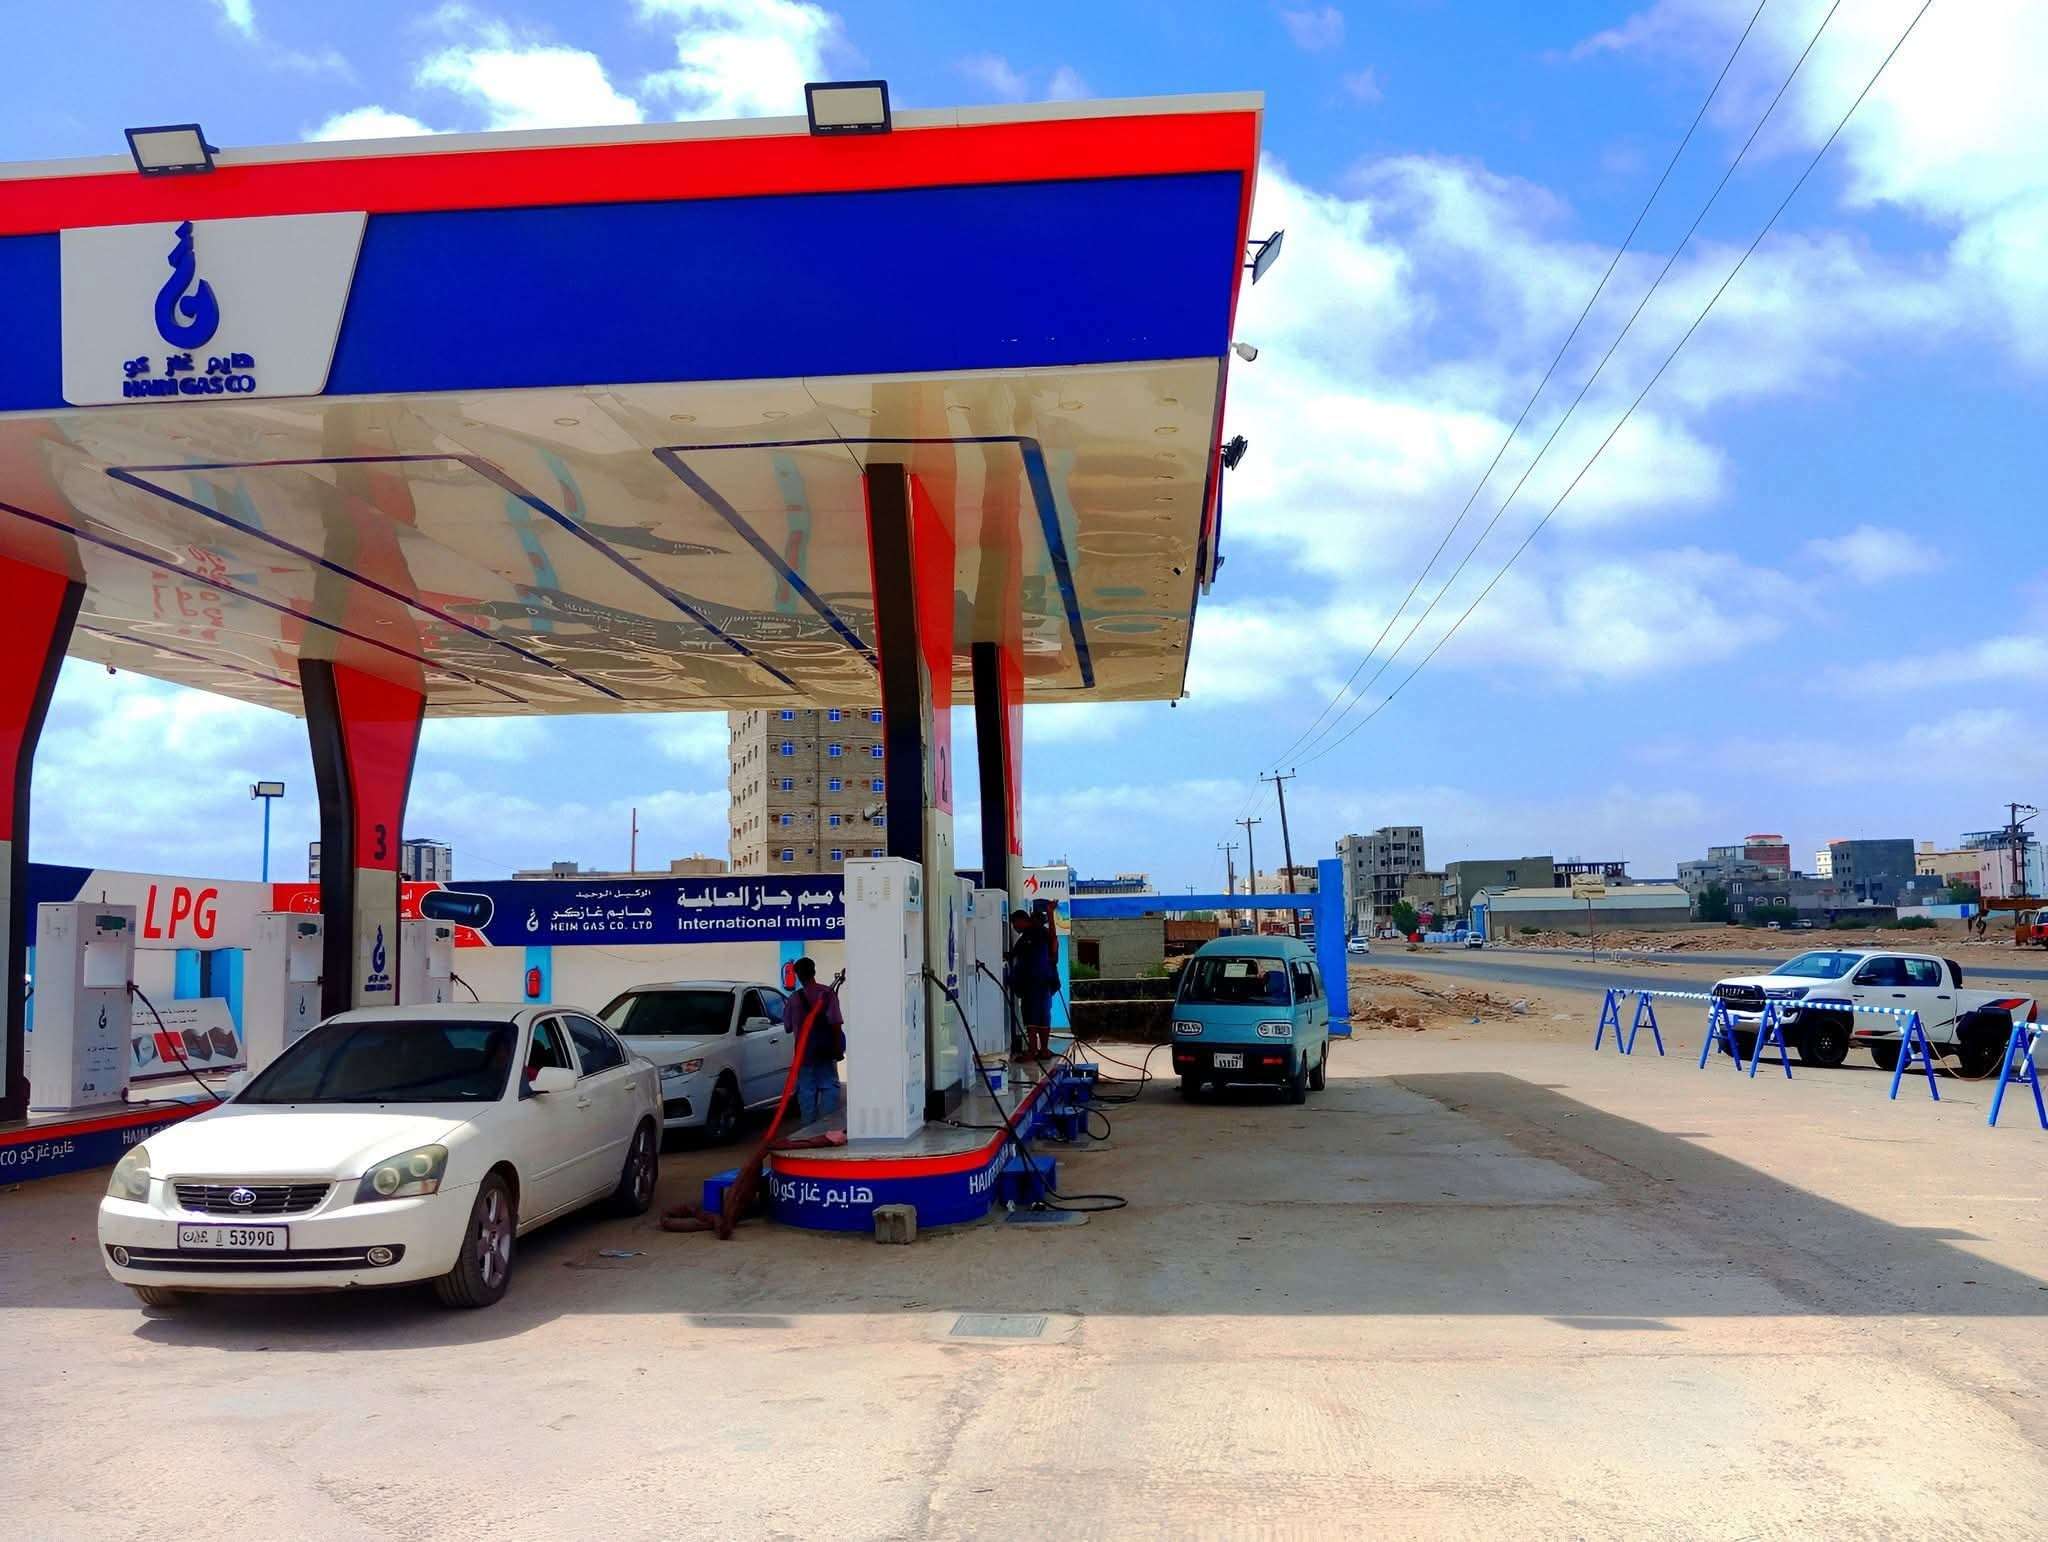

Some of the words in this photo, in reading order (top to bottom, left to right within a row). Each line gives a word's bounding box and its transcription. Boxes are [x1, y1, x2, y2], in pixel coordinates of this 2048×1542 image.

[179, 376, 224, 395] GAS
[224, 374, 256, 393] CO
[374, 824, 386, 860] 3
[1040, 880, 1064, 888] mim
[798, 889, 834, 911] ميم
[144, 885, 218, 939] LPG
[607, 905, 652, 920] هايم
[677, 915, 781, 930] International
[786, 915, 821, 927] mim
[550, 921, 578, 931] HEIM
[583, 921, 605, 930] GAS
[632, 921, 652, 929] LTD
[781, 1181, 796, 1202] كو
[798, 1183, 821, 1204] غاز
[822, 1185, 873, 1208] هايم
[230, 1230, 274, 1246] 53990
